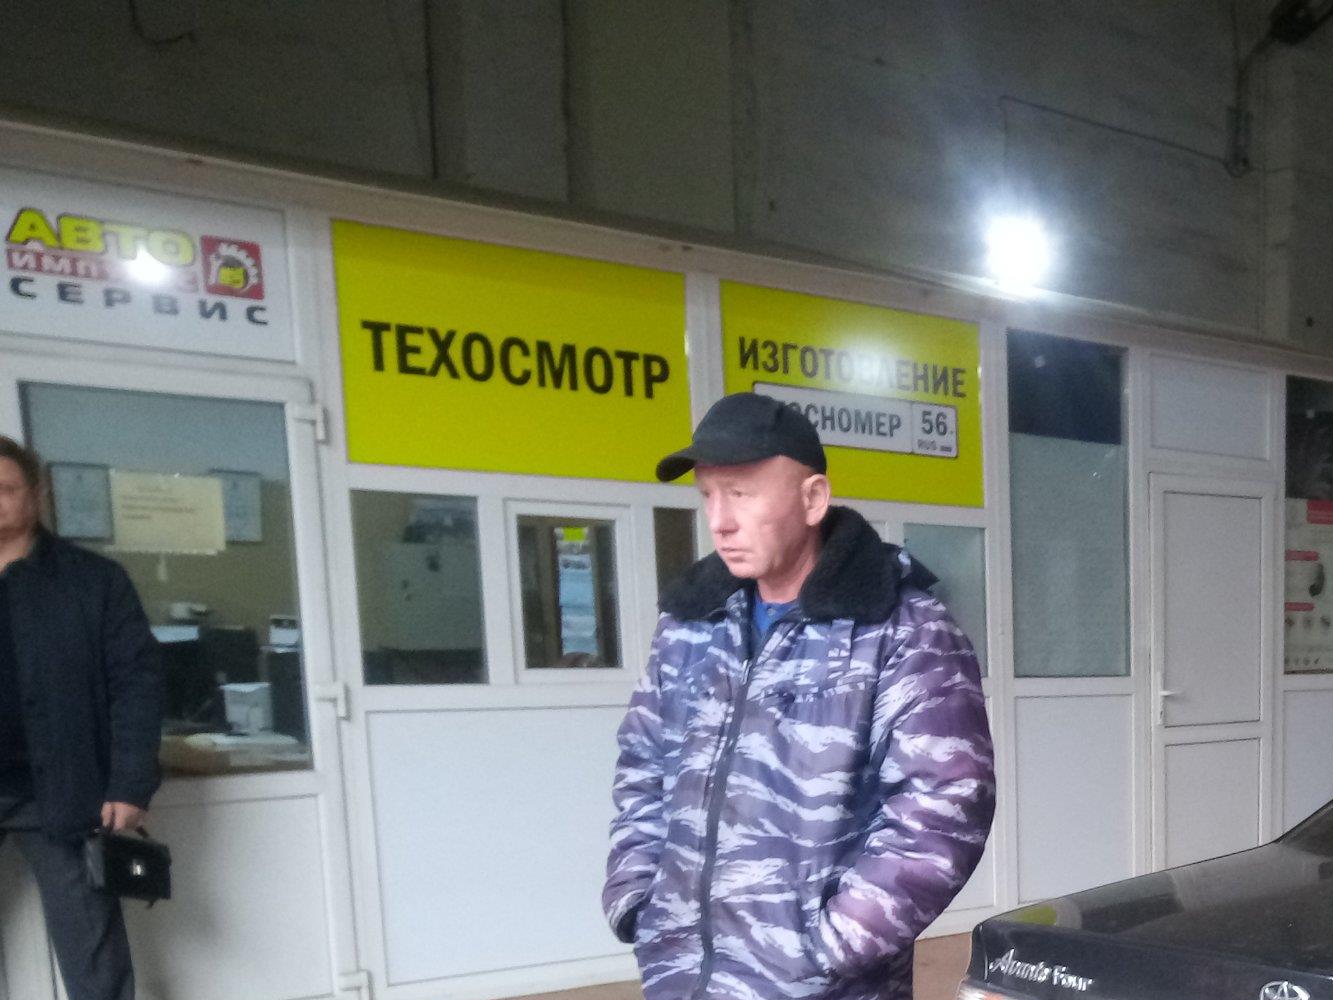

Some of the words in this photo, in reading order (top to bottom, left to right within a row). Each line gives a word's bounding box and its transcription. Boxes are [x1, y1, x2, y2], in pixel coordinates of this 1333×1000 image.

[5, 206, 197, 267] АВТО
[9, 275, 269, 326] СЕРВИС
[361, 319, 671, 400] ТЕХОСМОТР
[784, 402, 902, 438] СНОМЕР
[921, 410, 948, 436] 56
